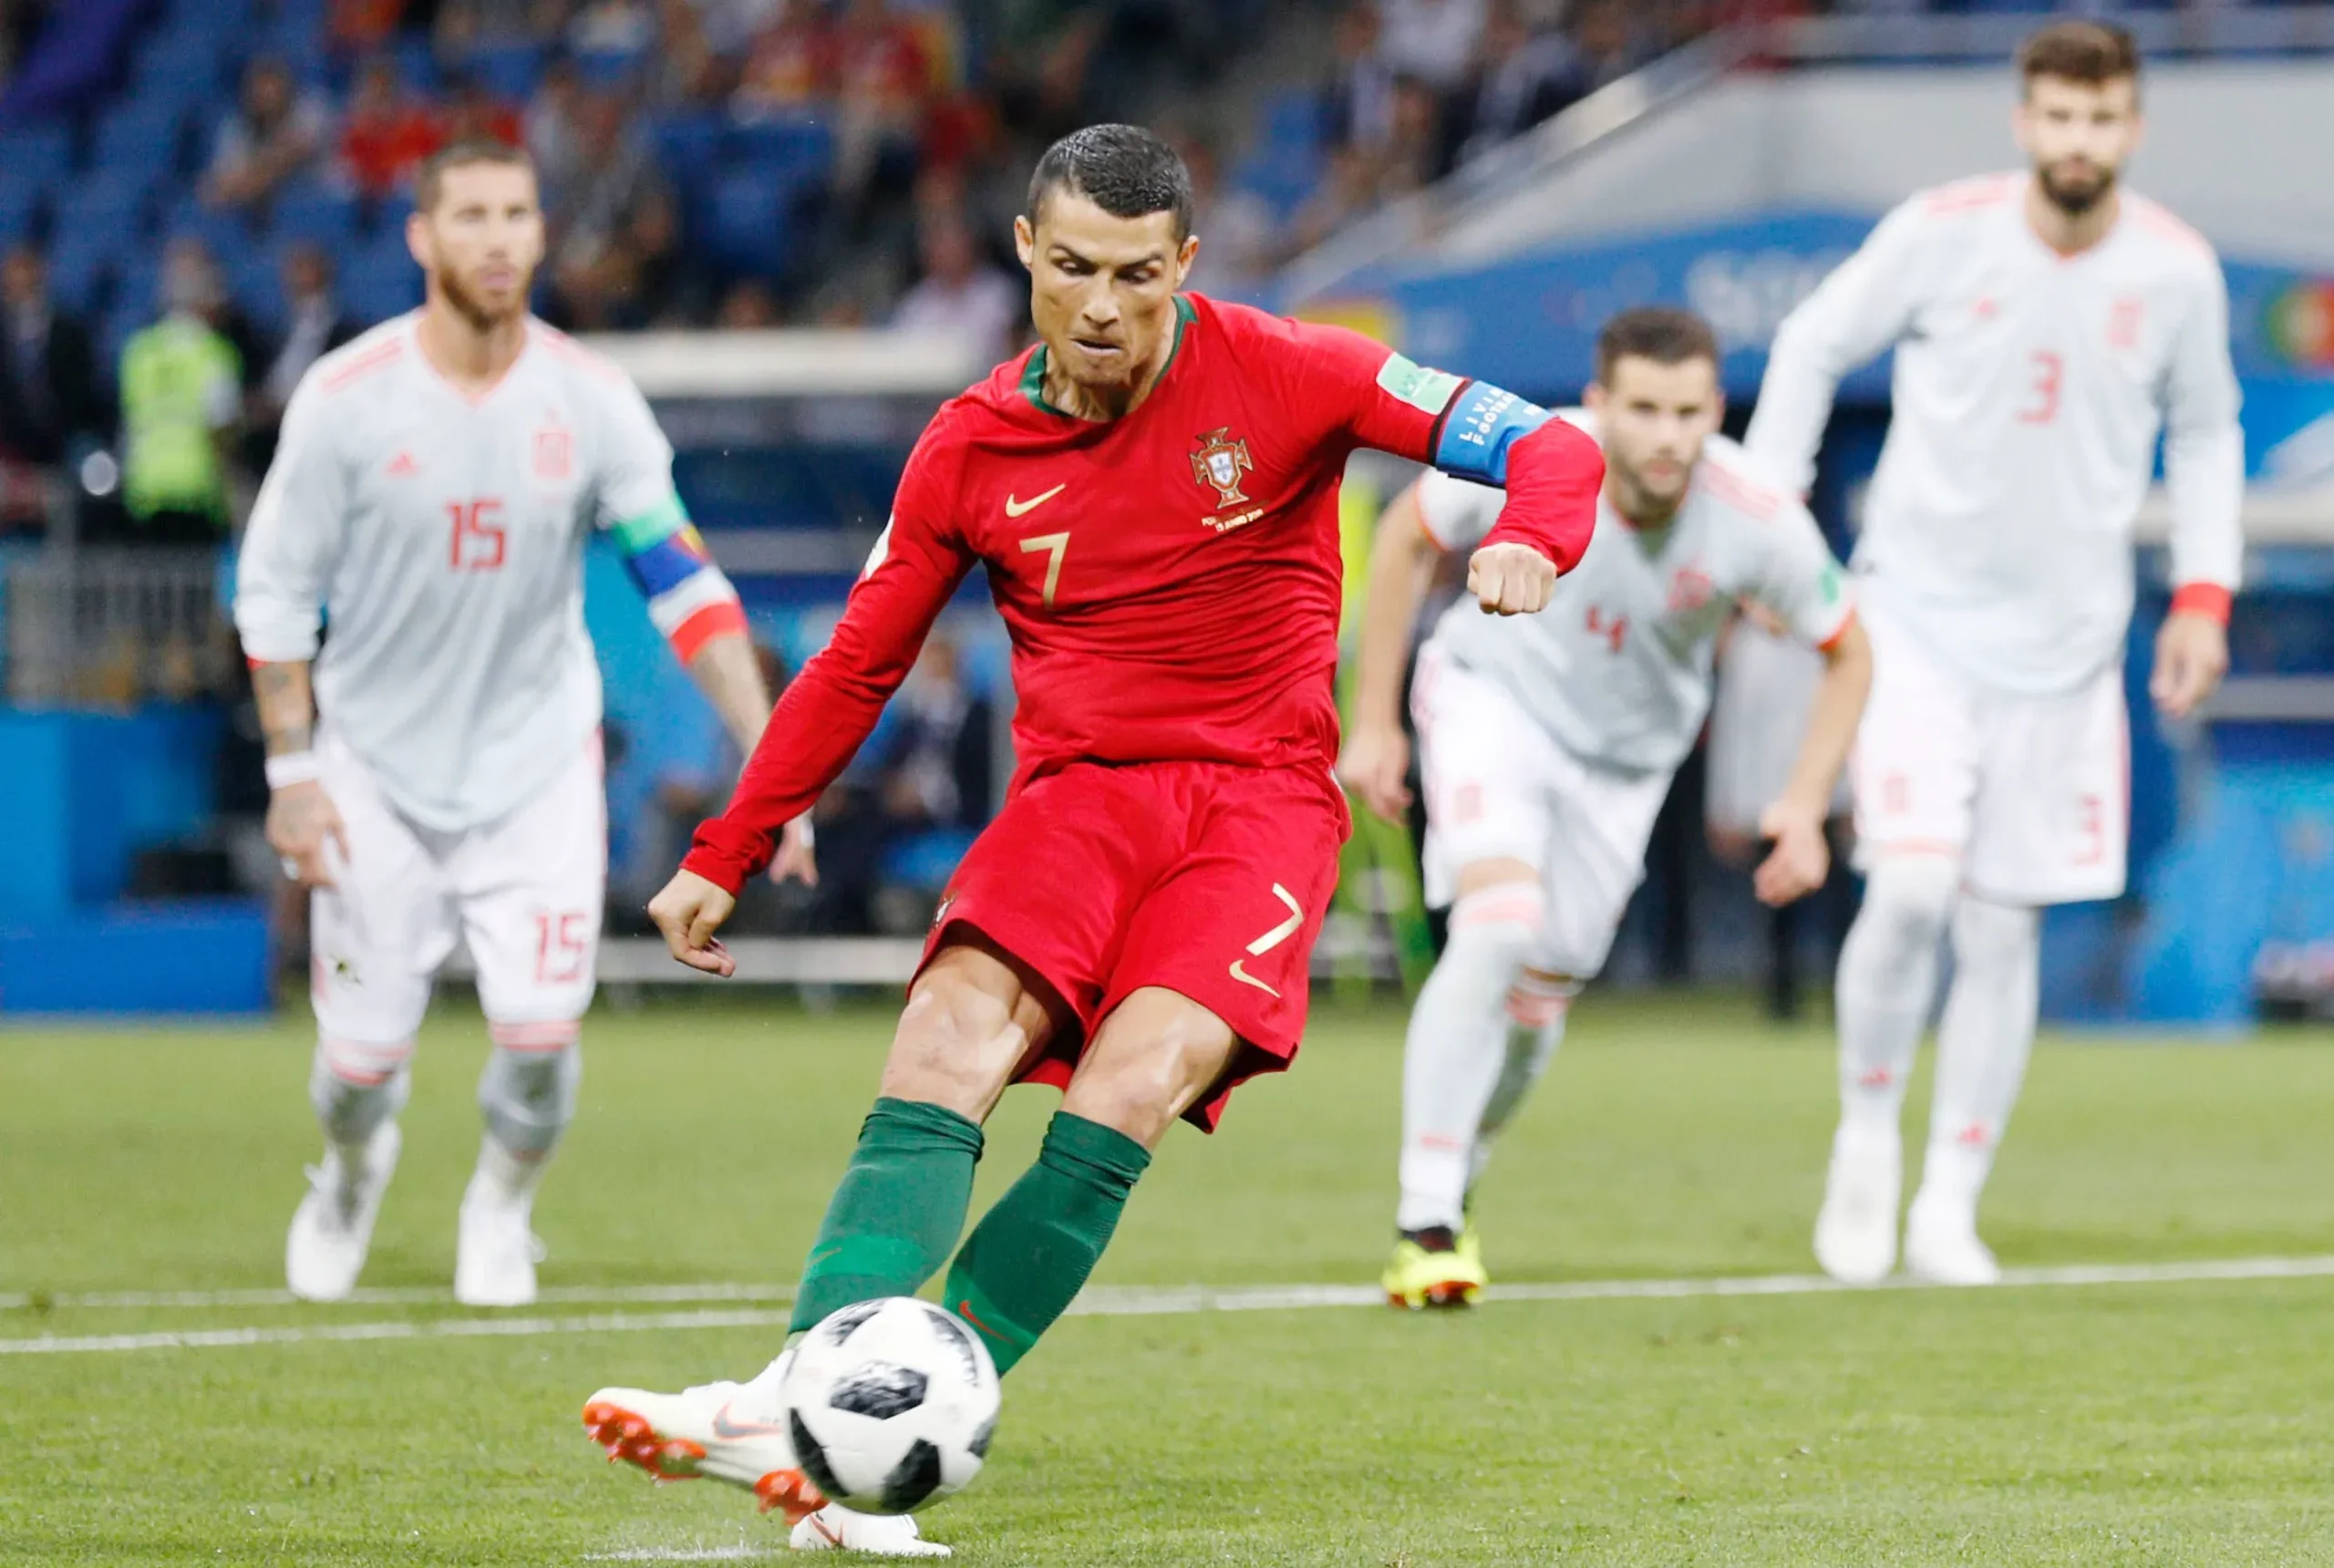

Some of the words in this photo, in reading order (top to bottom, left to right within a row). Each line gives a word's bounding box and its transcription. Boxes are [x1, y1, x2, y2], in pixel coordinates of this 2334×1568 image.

[2017, 350, 2063, 426] 3
[445, 499, 505, 572] 15
[1018, 531, 1071, 613] 7
[1585, 603, 1627, 655] 4
[2070, 795, 2105, 867] 3
[533, 913, 586, 983] 15
[1245, 882, 1305, 957] 7
